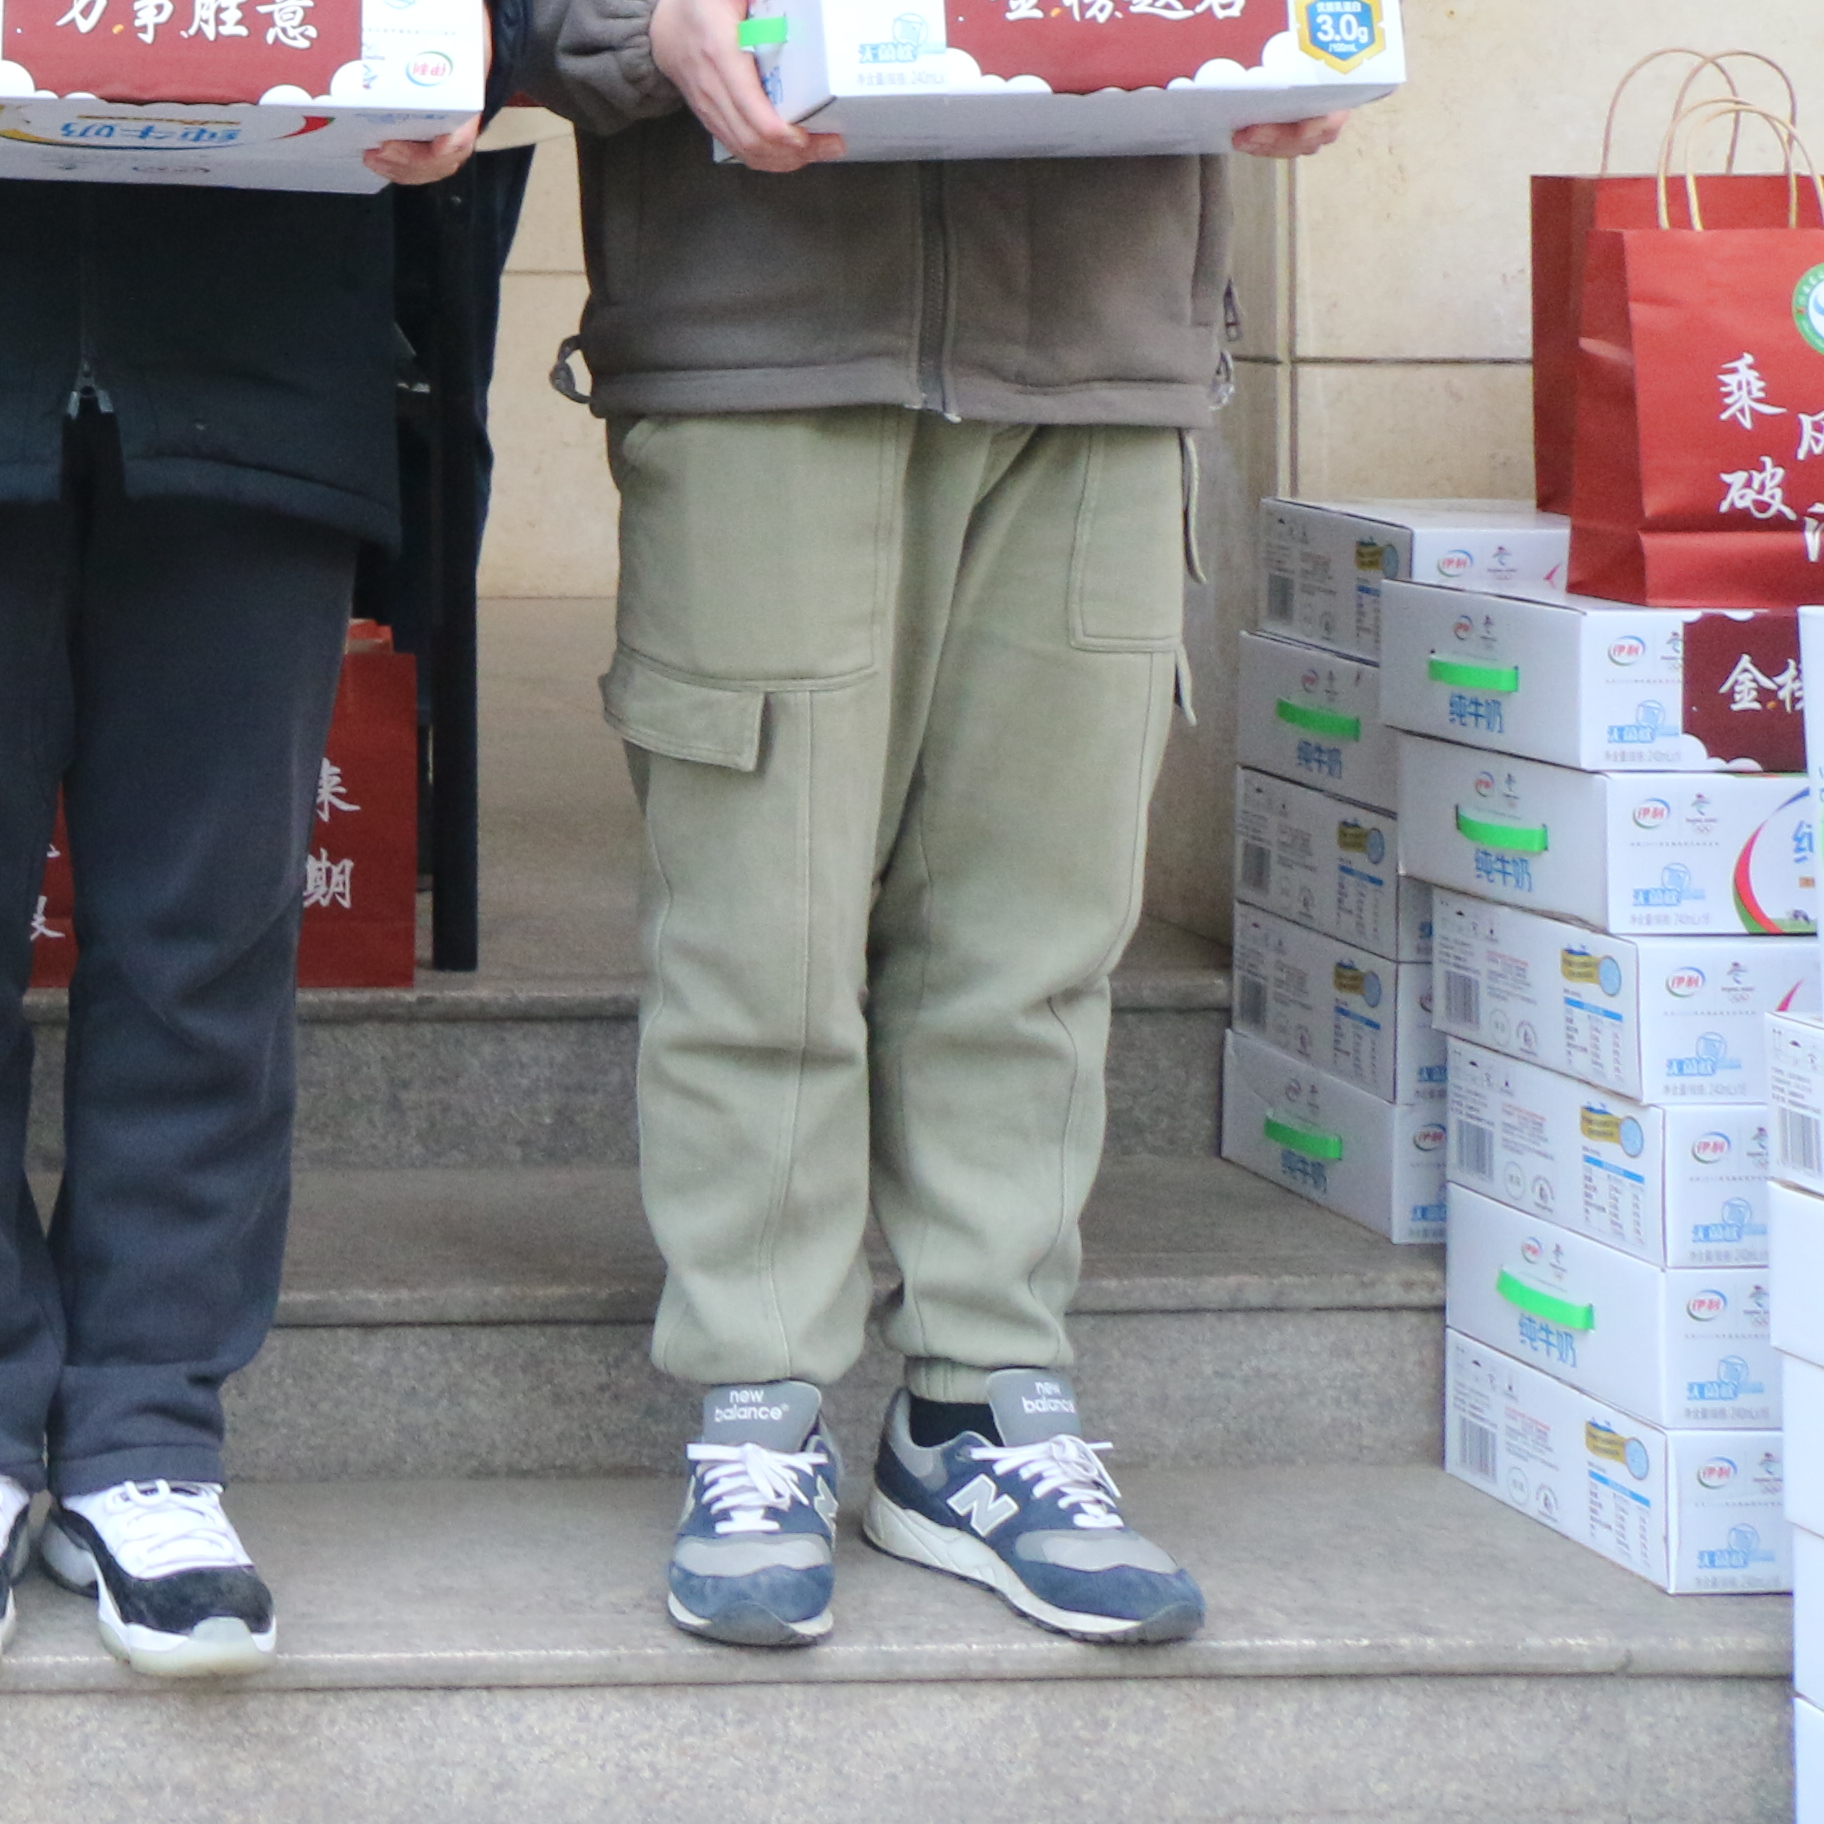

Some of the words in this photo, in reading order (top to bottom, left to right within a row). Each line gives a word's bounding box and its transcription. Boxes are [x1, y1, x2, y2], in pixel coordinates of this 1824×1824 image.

[1316, 13, 1369, 44] 3.0g
[1448, 691, 1505, 734] 纯牛奶
[1473, 847, 1535, 894] 纯牛奶
[1518, 1314, 1577, 1369] 纯牛奶
[729, 1388, 765, 1405] new
[1034, 1379, 1062, 1397] new
